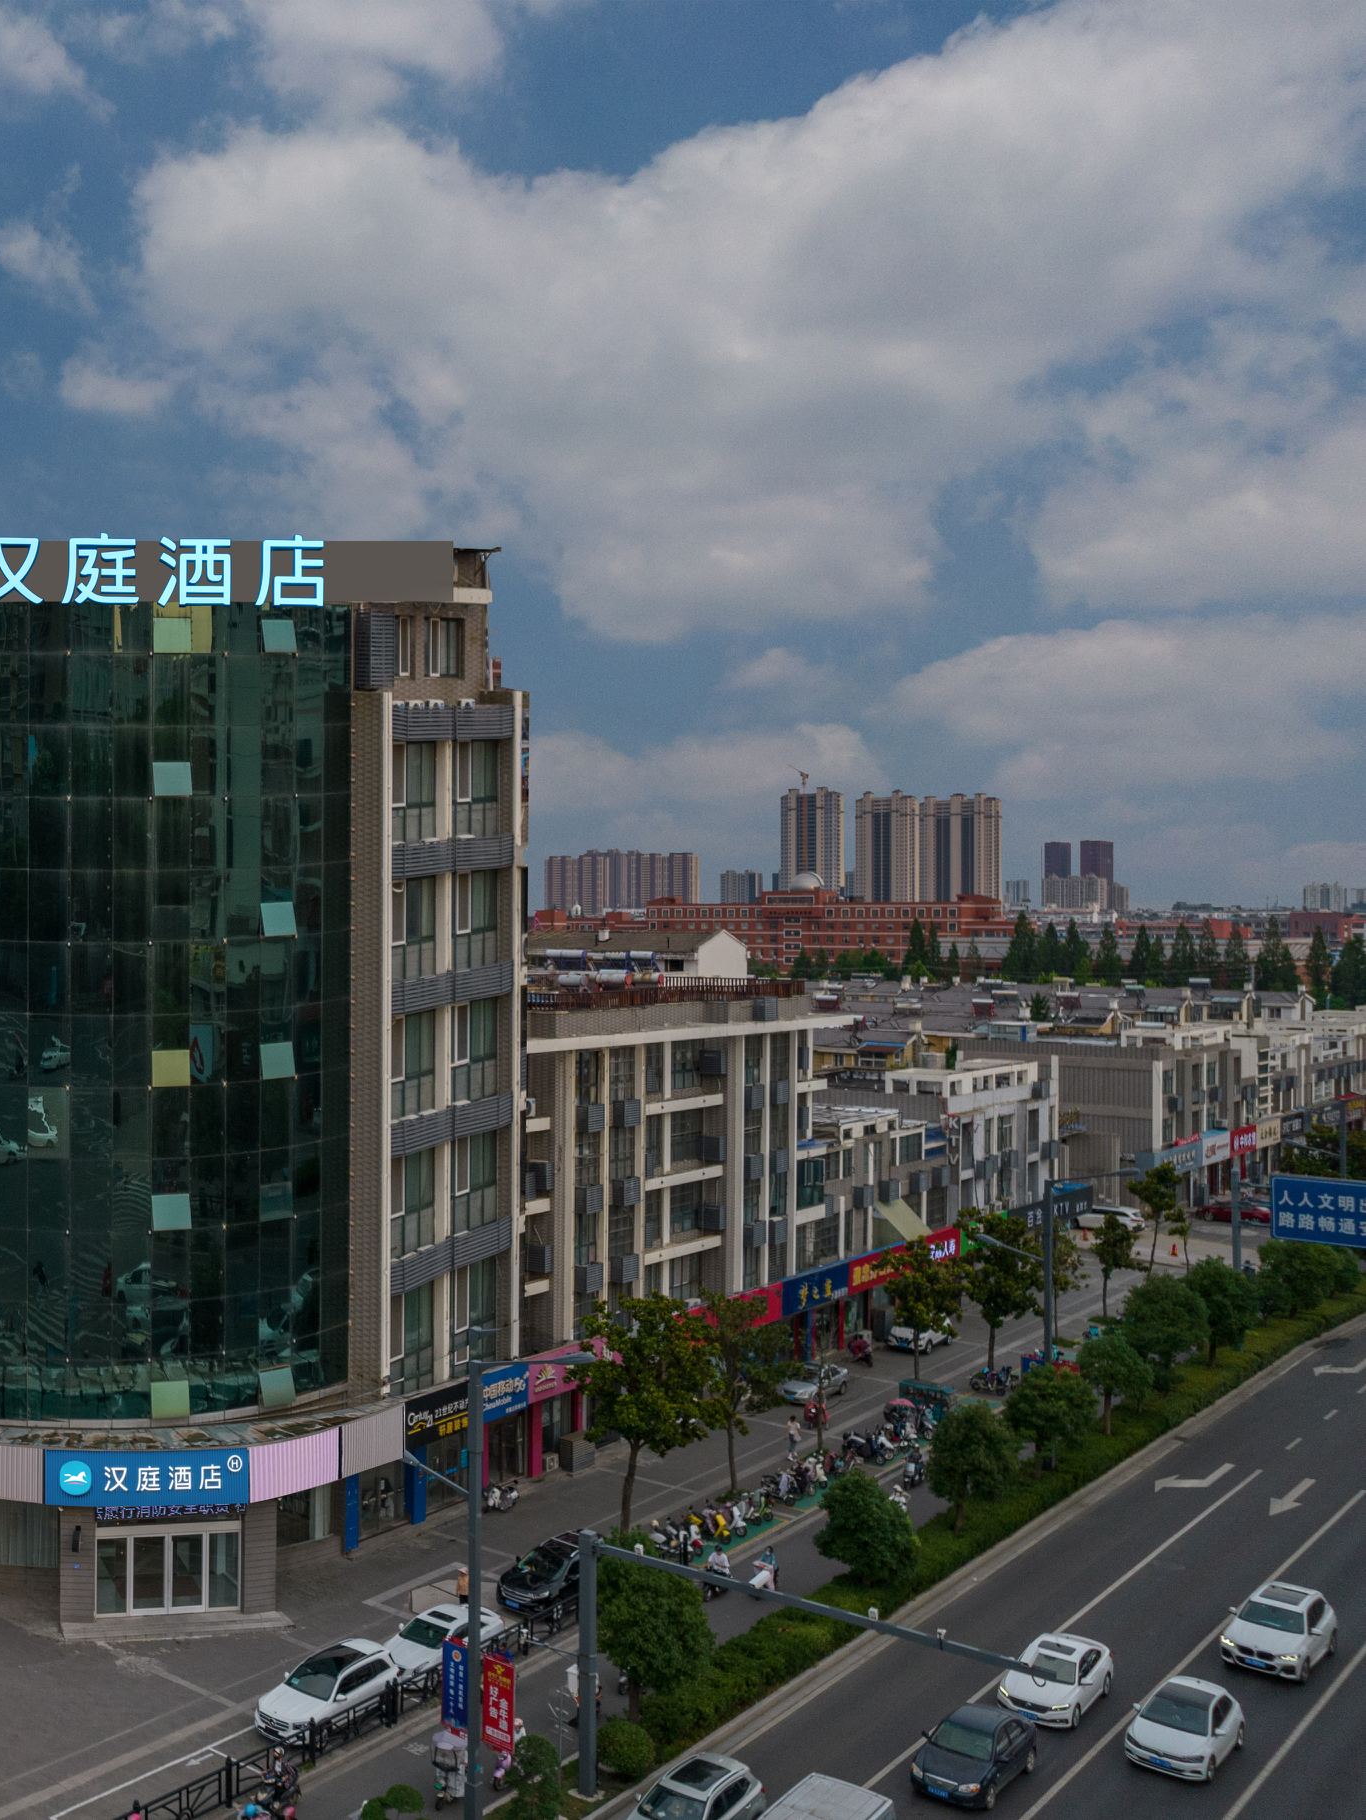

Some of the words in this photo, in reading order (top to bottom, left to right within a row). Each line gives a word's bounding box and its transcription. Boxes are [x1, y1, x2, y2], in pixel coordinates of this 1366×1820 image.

[948, 1117, 960, 1166] KTV
[483, 1377, 514, 1402] 中国移动
[513, 1376, 526, 1393] 5G
[104, 1463, 222, 1492] 汉庭酒店
